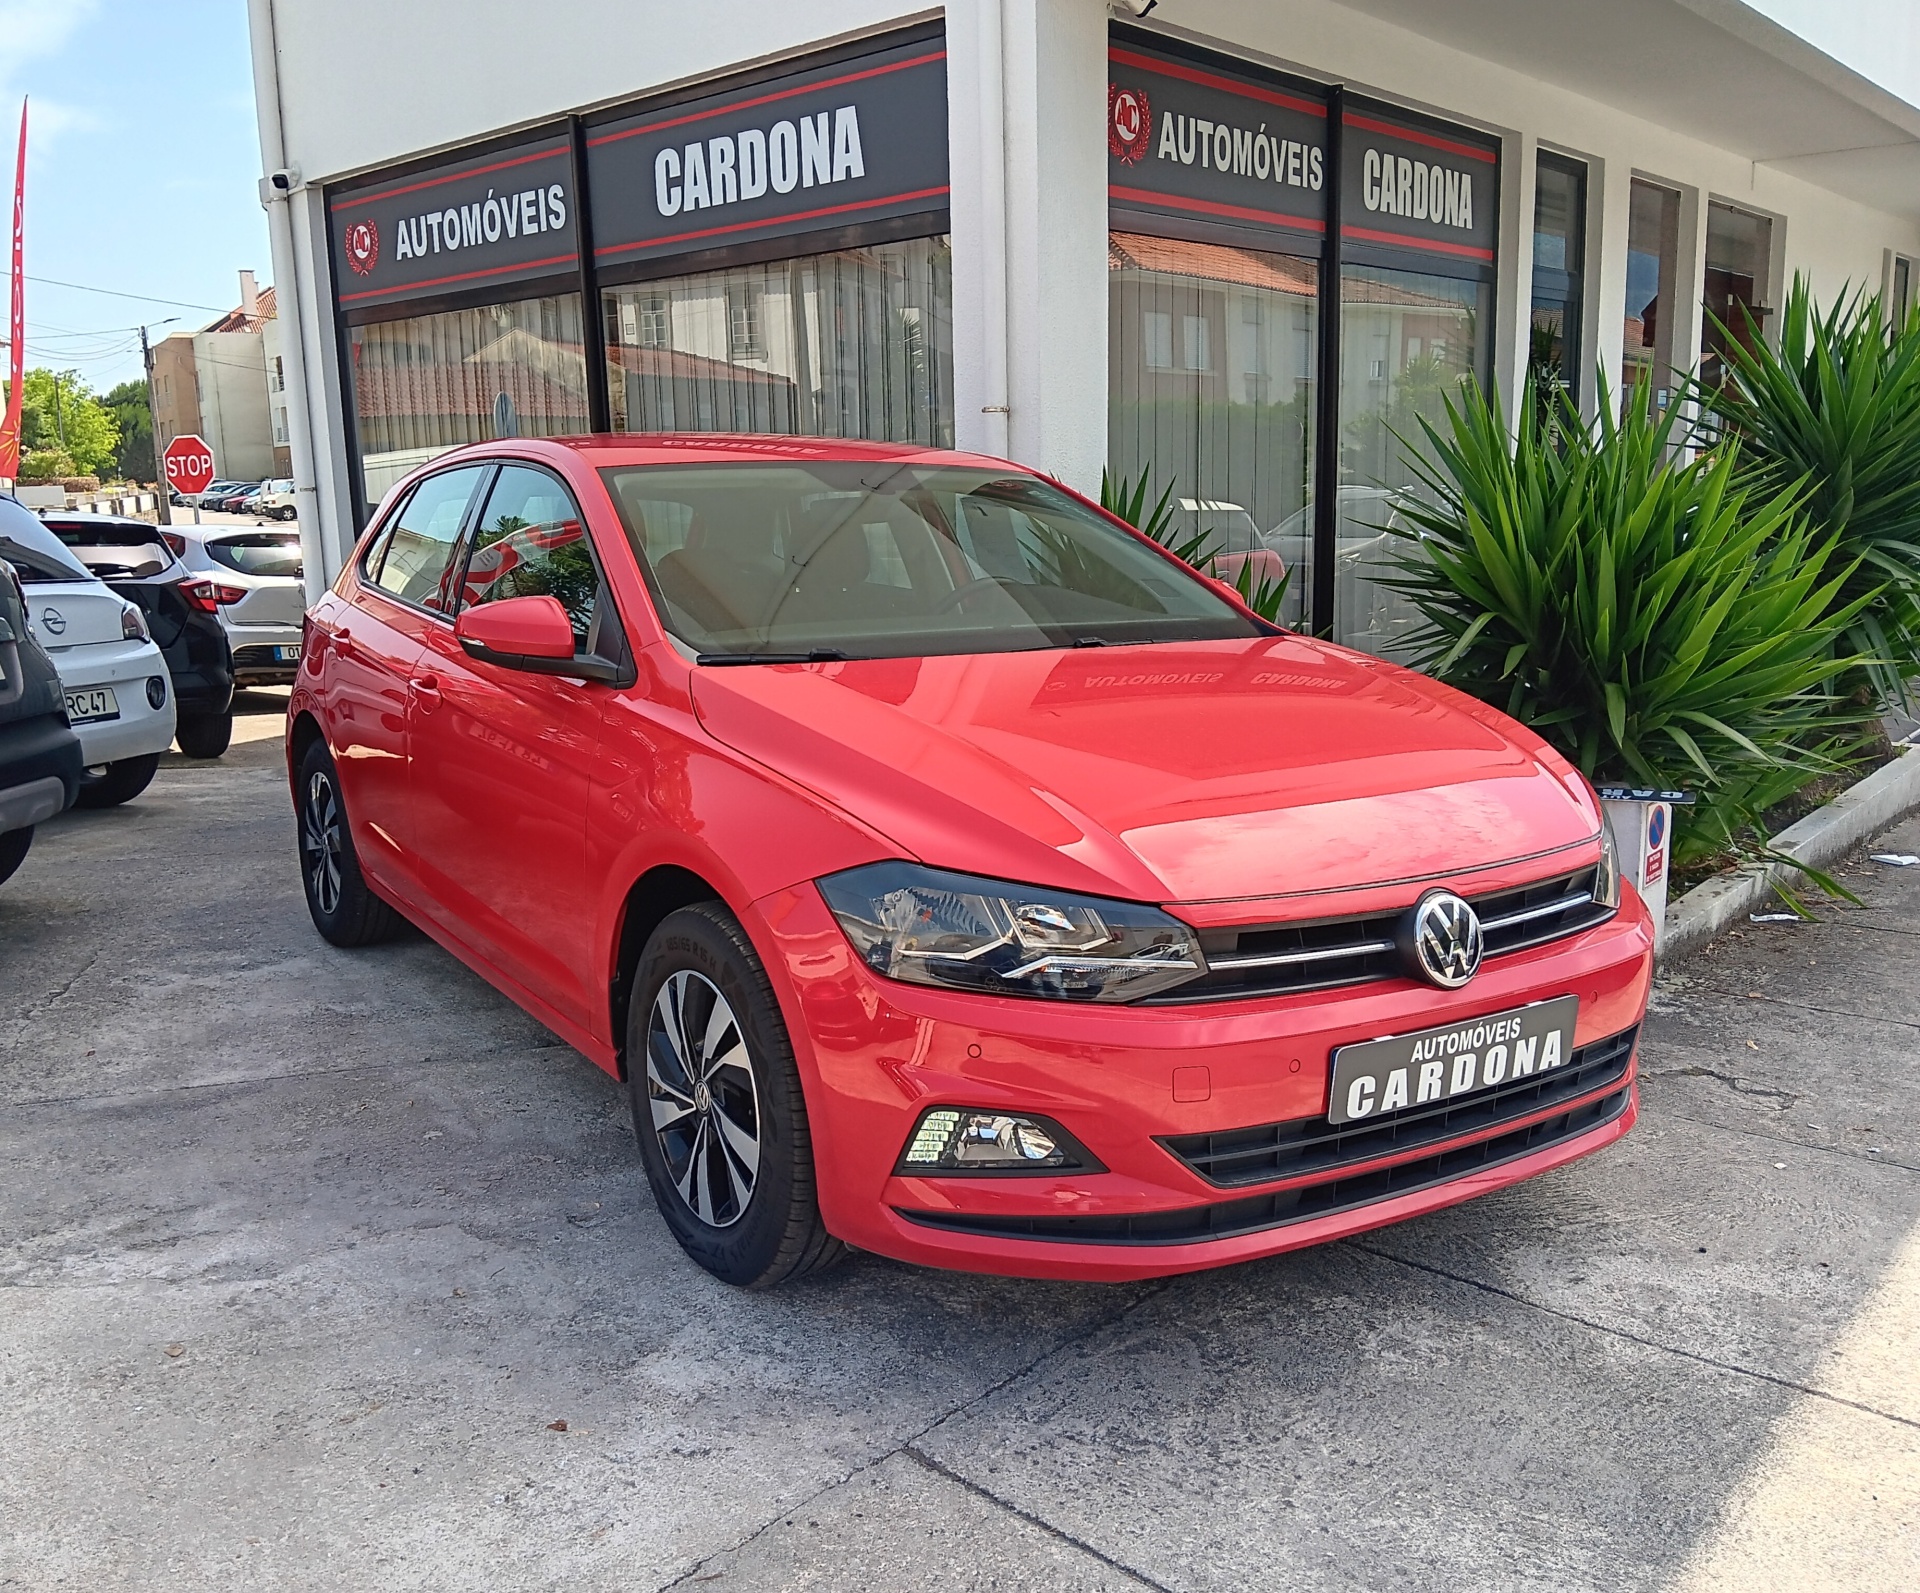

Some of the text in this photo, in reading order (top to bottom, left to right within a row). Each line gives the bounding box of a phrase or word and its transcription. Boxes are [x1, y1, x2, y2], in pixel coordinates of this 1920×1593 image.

[395, 105, 866, 261] AUTOMÓVEIS CARDONA
[1157, 111, 1473, 230] AUTOMÓVEIS CARDONA
[165, 451, 213, 479] STOP
[66, 691, 106, 716] RC 47
[1346, 1029, 1562, 1120] CARDONA
[1410, 1017, 1522, 1064] AUTOMÓVEIS
